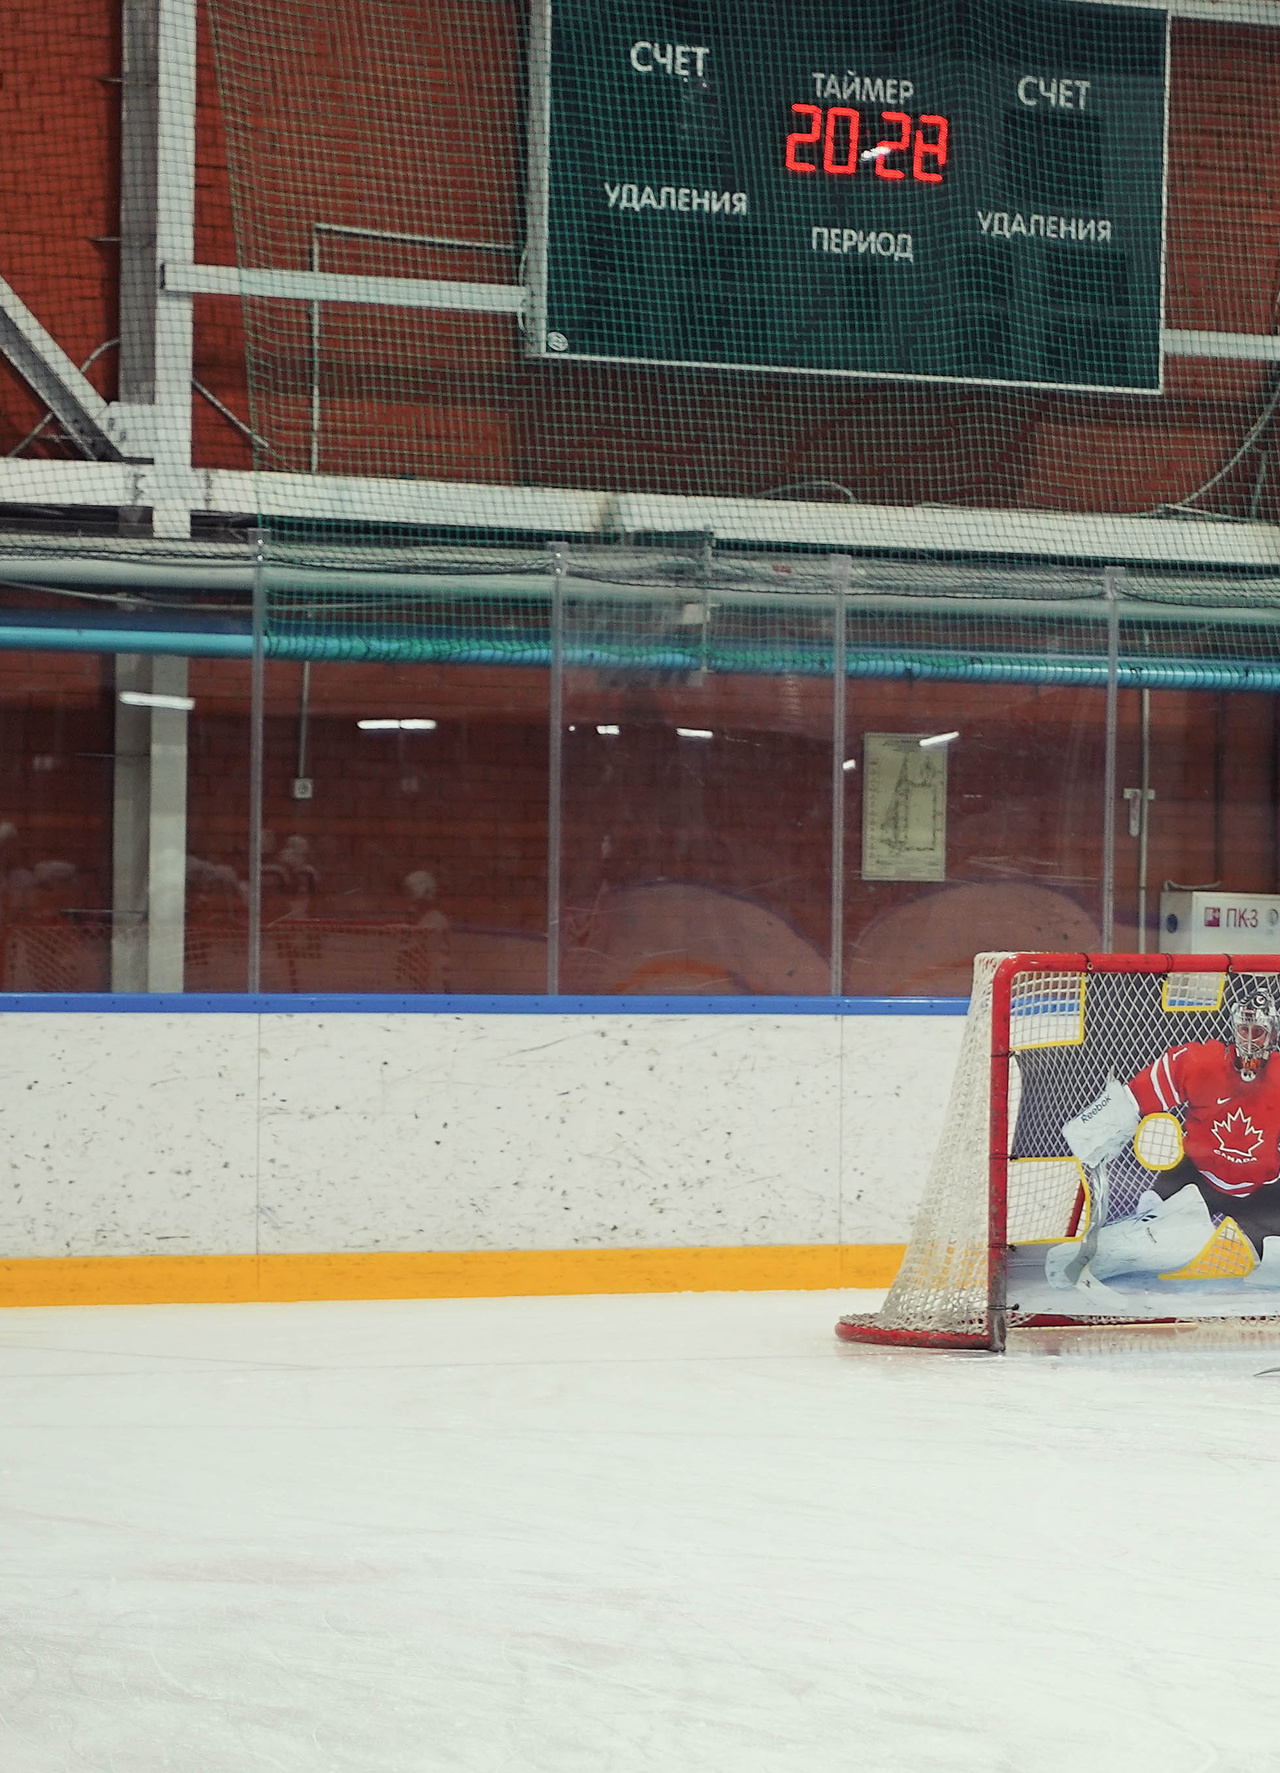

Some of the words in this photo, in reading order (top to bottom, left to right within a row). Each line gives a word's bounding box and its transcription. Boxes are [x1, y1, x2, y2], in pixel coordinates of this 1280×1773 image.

[630, 41, 710, 76] СЧЕТ
[812, 70, 914, 105] ТАЙМЕР
[1018, 76, 1091, 110] СЧЕТ
[604, 182, 748, 216] УДАЛЕНИЯ
[812, 226, 914, 262] ПЕРИОД
[977, 211, 1112, 243] УДАЛЕНИЯ
[1226, 908, 1258, 928] ПК-3
[1081, 1095, 1112, 1124] Reebok
[1213, 1149, 1258, 1163] CANADA
